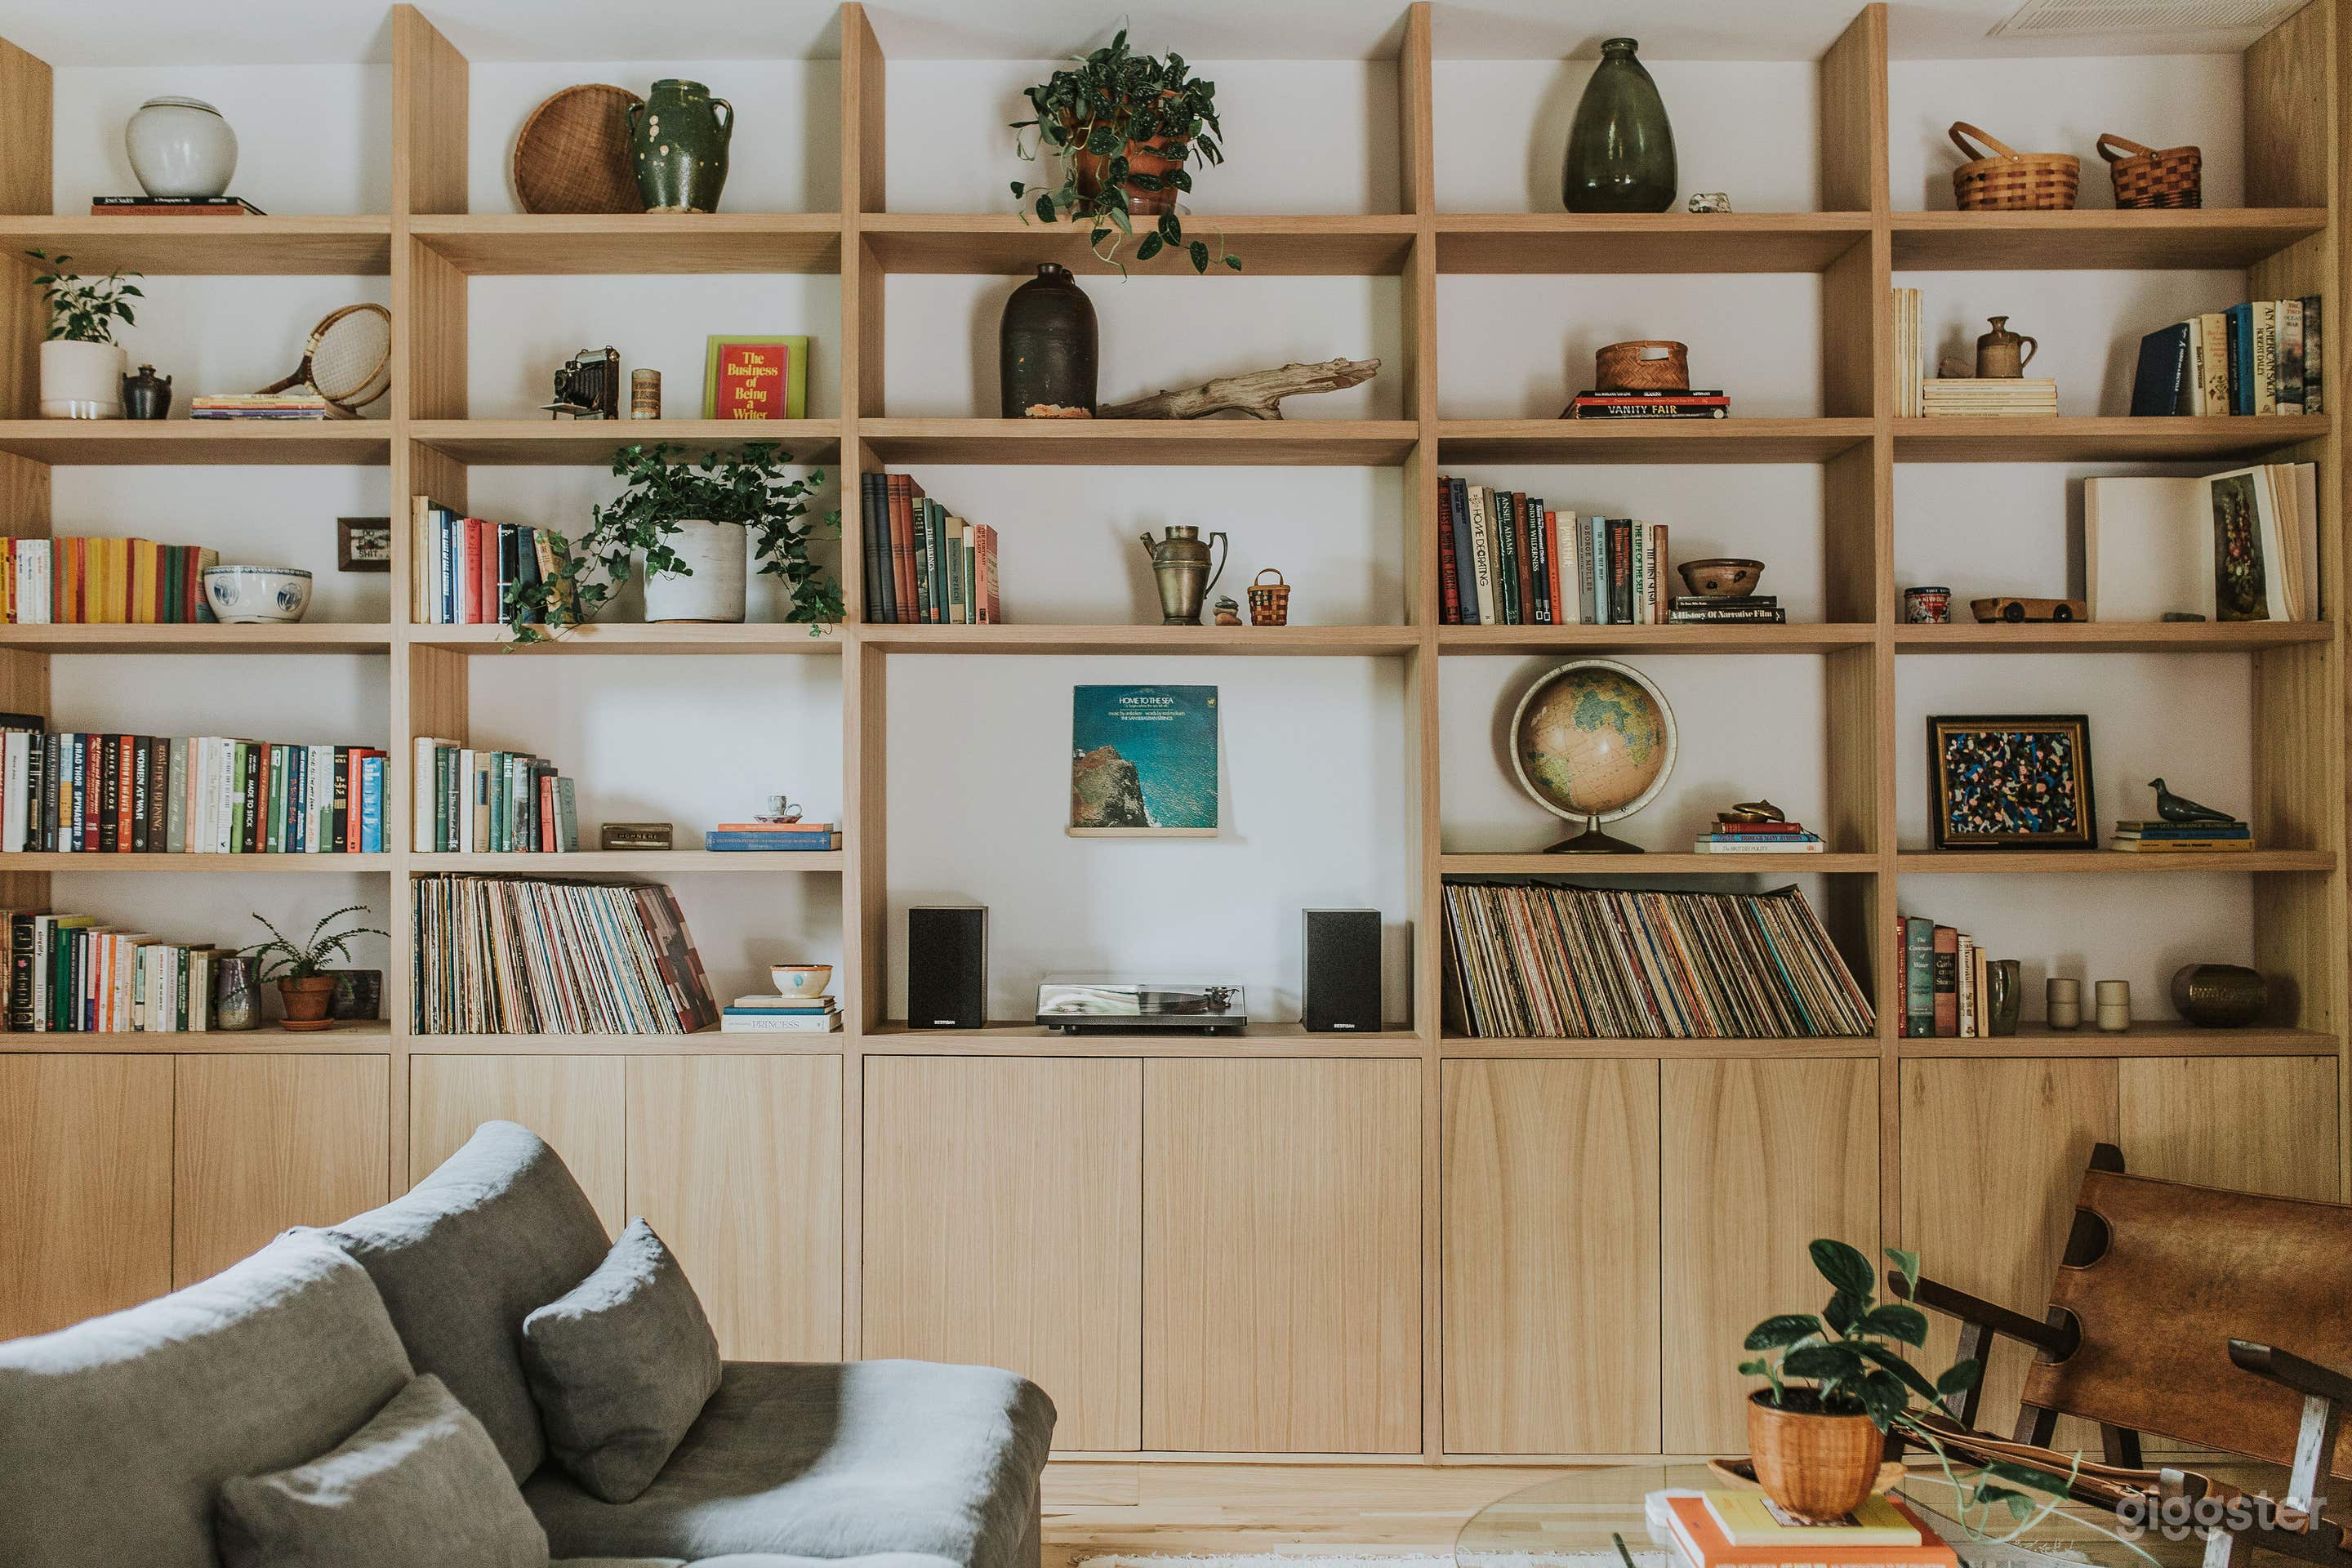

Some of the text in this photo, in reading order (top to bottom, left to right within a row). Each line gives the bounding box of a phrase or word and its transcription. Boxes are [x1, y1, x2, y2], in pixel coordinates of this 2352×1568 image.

[742, 352, 764, 364] The
[2265, 307, 2275, 397] AN AMERICAN SAGA
[728, 363, 778, 376] Business
[746, 376, 759, 387] of
[735, 387, 768, 402] Being
[746, 400, 754, 409] a
[1608, 405, 1677, 413] VANITY FAIR
[733, 408, 768, 419] Writer
[1439, 493, 1450, 526] GREATEST
[977, 526, 982, 534] OF
[1473, 510, 1484, 537] HOME
[1502, 497, 1514, 555] ANSEL ADAMS
[1442, 531, 1452, 550] SHOW
[1614, 528, 1622, 551] William
[1635, 540, 1643, 552] LIFE
[359, 549, 378, 558] SHIT
[1444, 555, 1454, 564] ON
[1530, 530, 1539, 572] WILDERNESS
[1635, 554, 1642, 564] OF
[1446, 567, 1455, 590] EARTH
[1646, 563, 1655, 578] FIRST
[1679, 612, 1706, 620] History
[1707, 611, 1717, 619] Of
[1754, 609, 1772, 617] Film
[74, 743, 82, 764] BRAD
[122, 750, 131, 777] WINDOW
[136, 749, 145, 820] WOMEN AT WAR
[155, 766, 164, 791] EDEN
[121, 786, 130, 813] HEAVEN
[247, 800, 254, 808] TO
[74, 791, 82, 836] SPYMASTER
[152, 792, 163, 831] BURNING
[36, 931, 44, 956] simplify
[752, 1021, 800, 1029] PRINCESS
